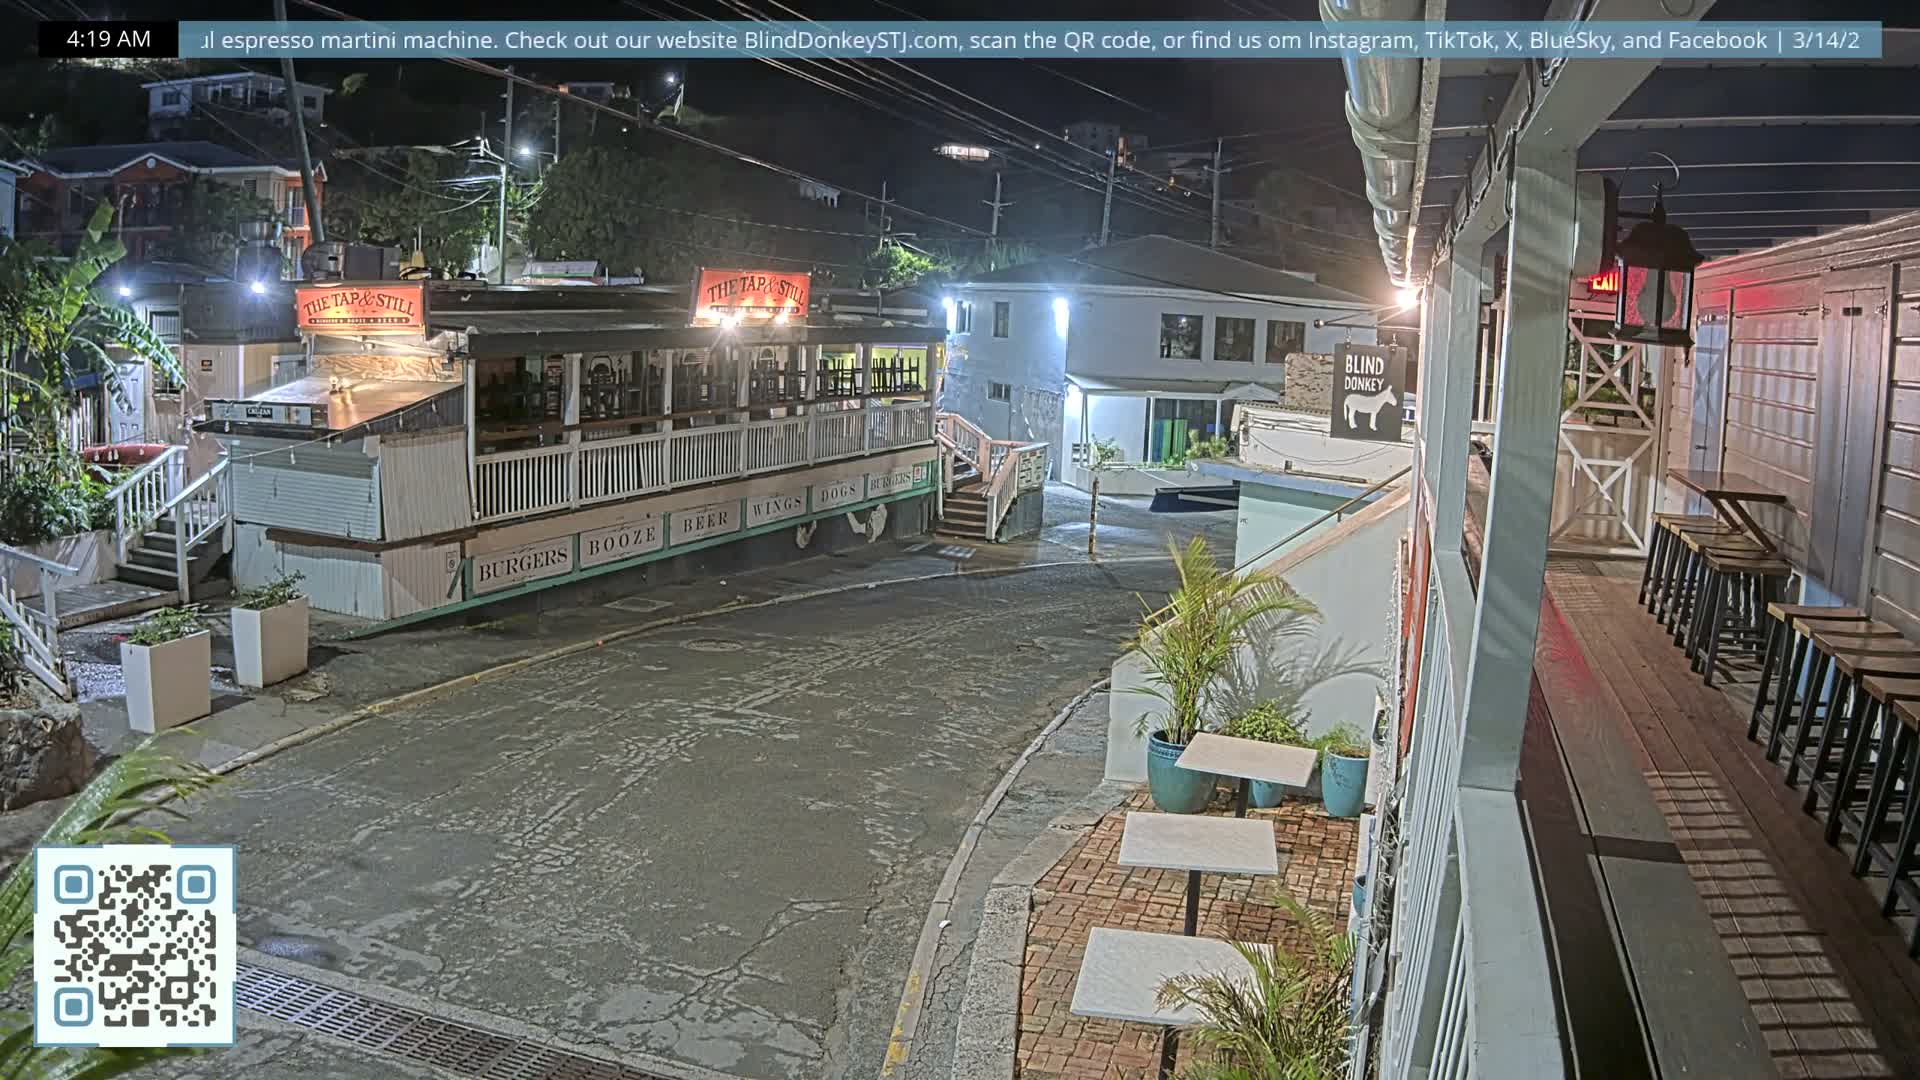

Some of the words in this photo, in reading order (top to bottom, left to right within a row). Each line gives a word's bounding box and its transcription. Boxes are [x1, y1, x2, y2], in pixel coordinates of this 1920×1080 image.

[707, 278, 738, 303] THE
[740, 275, 766, 292] TAP
[778, 280, 805, 306] STILL
[303, 296, 331, 317] THE
[331, 292, 360, 307] TAP
[375, 293, 416, 317] STILL
[1345, 354, 1385, 375] BLIND
[1344, 376, 1385, 392] DONKEY
[870, 471, 911, 491] BURGERS
[821, 484, 856, 503] DOGS
[753, 496, 802, 517] WINGS
[683, 511, 728, 533] BEER
[589, 527, 656, 556] BOOZE
[479, 548, 568, 582] BURGERS
